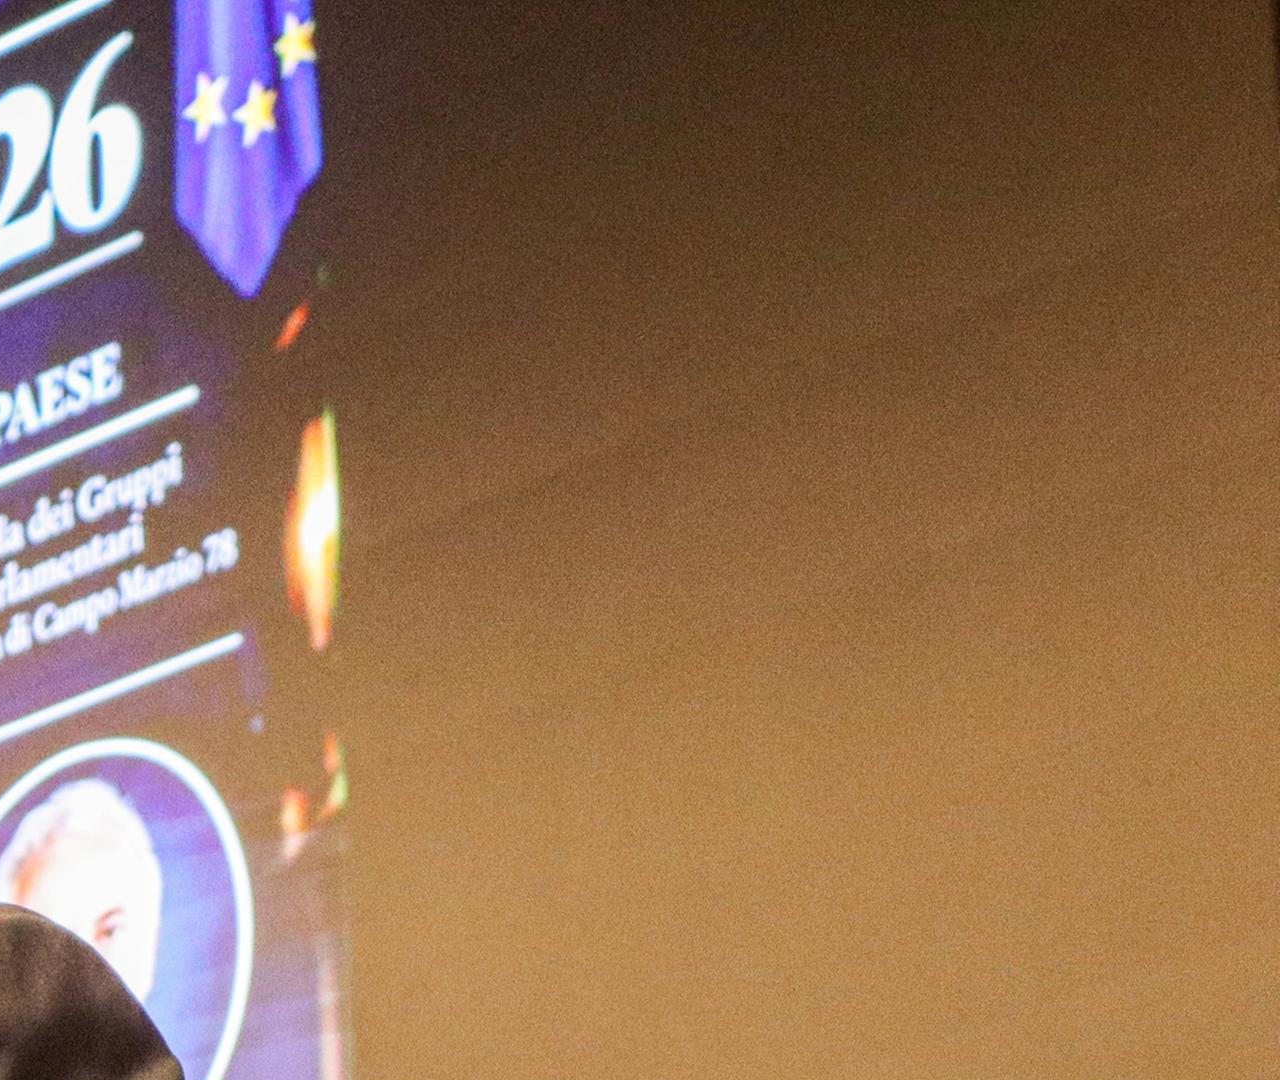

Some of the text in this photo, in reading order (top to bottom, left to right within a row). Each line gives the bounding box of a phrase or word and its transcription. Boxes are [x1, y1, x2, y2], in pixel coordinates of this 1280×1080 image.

[26, 488, 76, 544] dei
[76, 441, 182, 523] Gruppi
[4, 612, 33, 656] di
[32, 587, 119, 642] Campo
[118, 546, 204, 609] Marzio
[202, 527, 239, 573] 78
